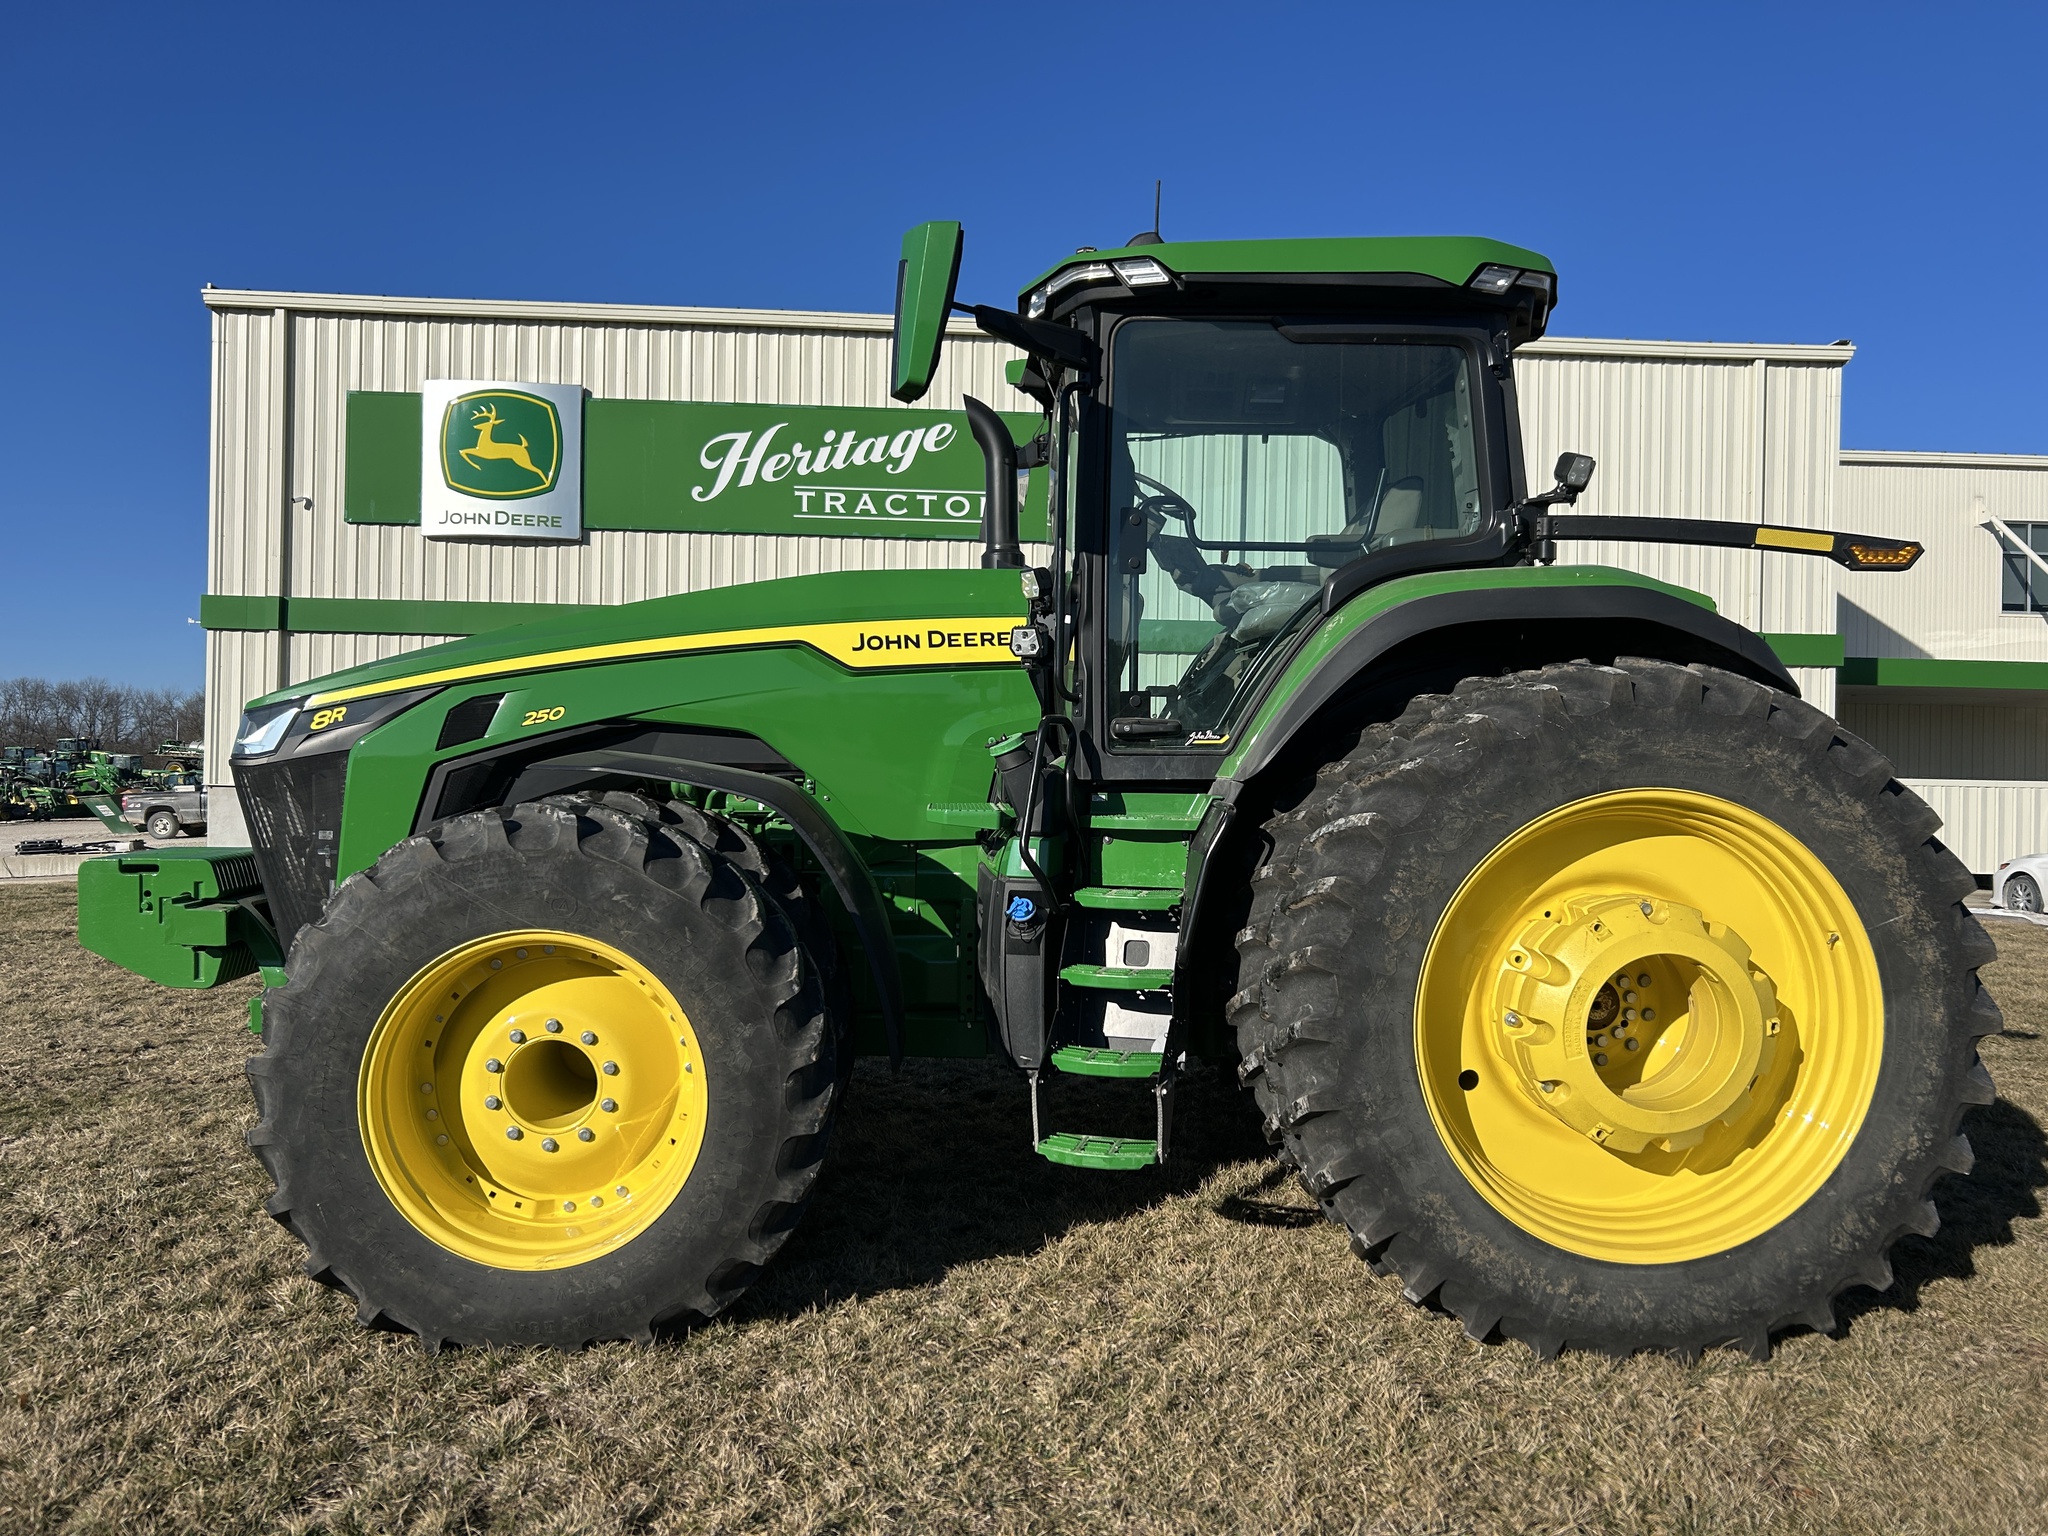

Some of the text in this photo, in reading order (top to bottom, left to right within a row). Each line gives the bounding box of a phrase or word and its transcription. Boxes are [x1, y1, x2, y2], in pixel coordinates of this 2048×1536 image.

[691, 422, 957, 502] Heritage
[438, 510, 563, 528] JOHN DEERE
[852, 630, 1011, 651] JOHN DEERE
[310, 706, 347, 730] 8R
[521, 705, 566, 727] 250
